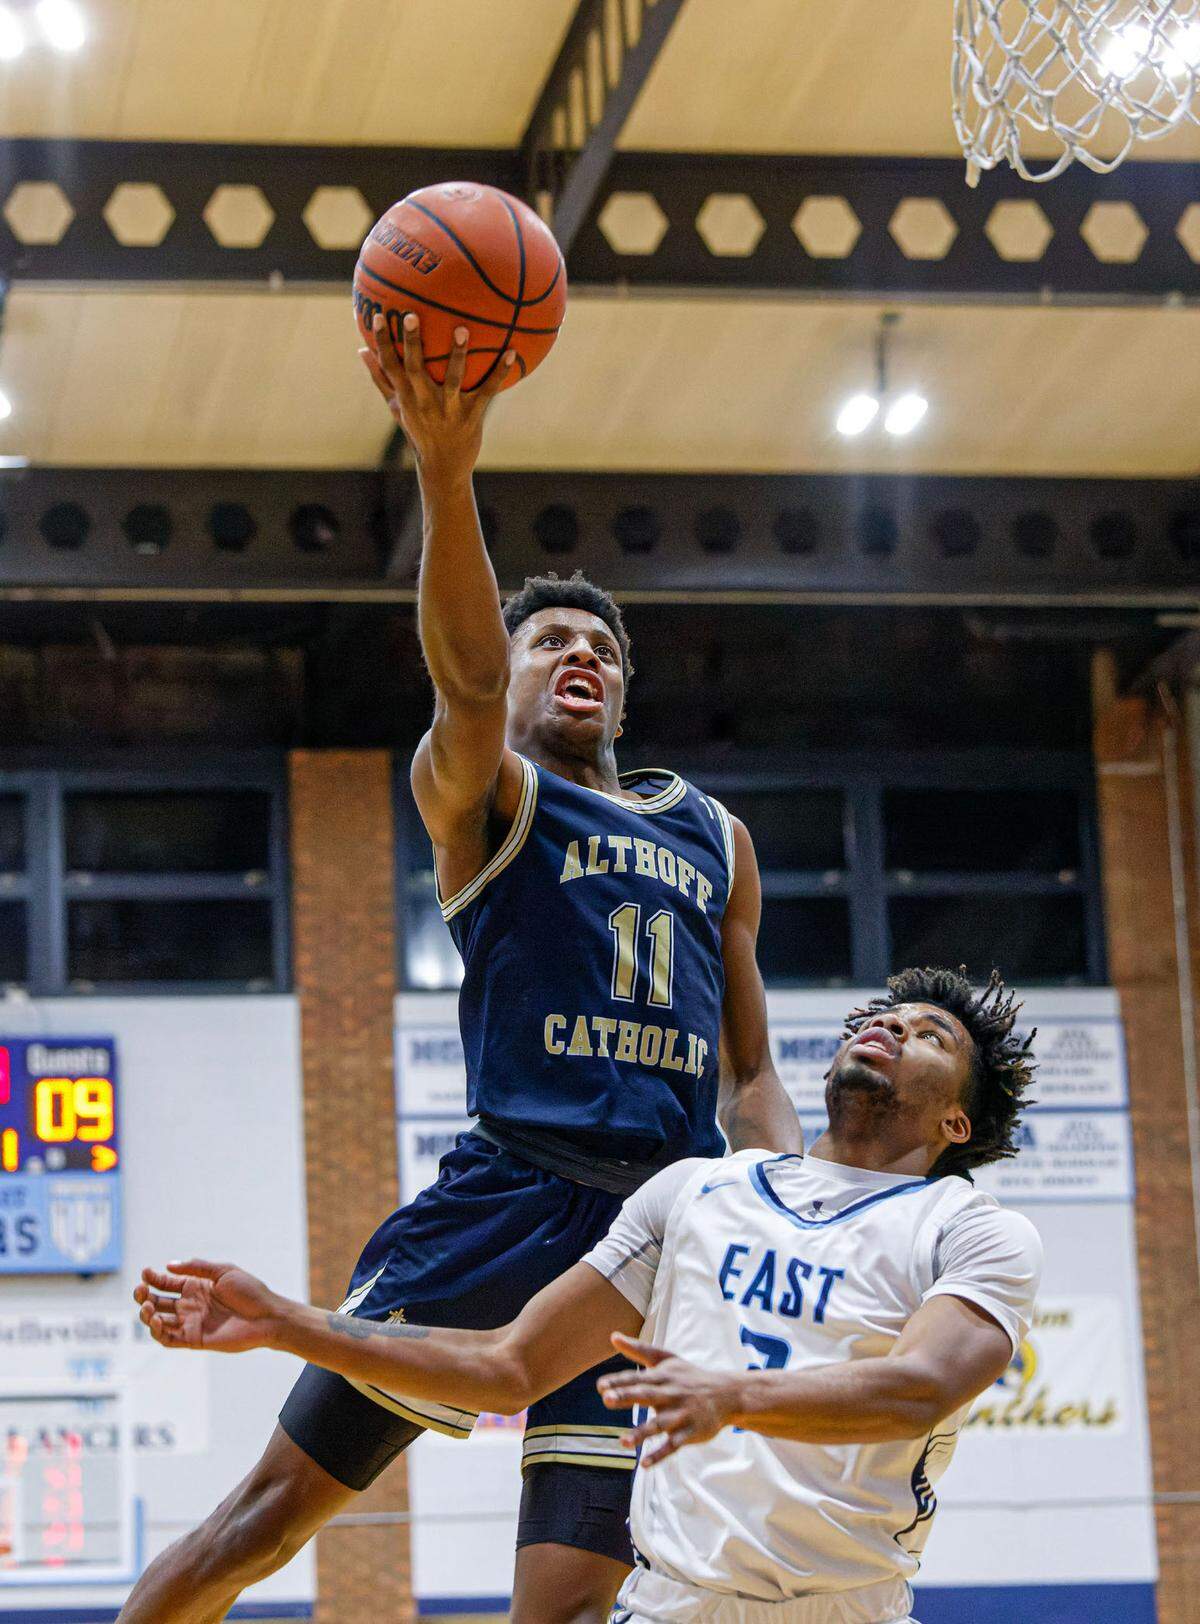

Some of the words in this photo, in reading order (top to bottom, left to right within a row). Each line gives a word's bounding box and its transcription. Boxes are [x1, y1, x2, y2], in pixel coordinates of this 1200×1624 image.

[559, 834, 713, 914] ALTHOFF
[608, 901, 674, 1009] 11
[543, 1013, 709, 1080] CATHOLIC
[35, 1076, 114, 1143] 09
[718, 1243, 846, 1325] EAST
